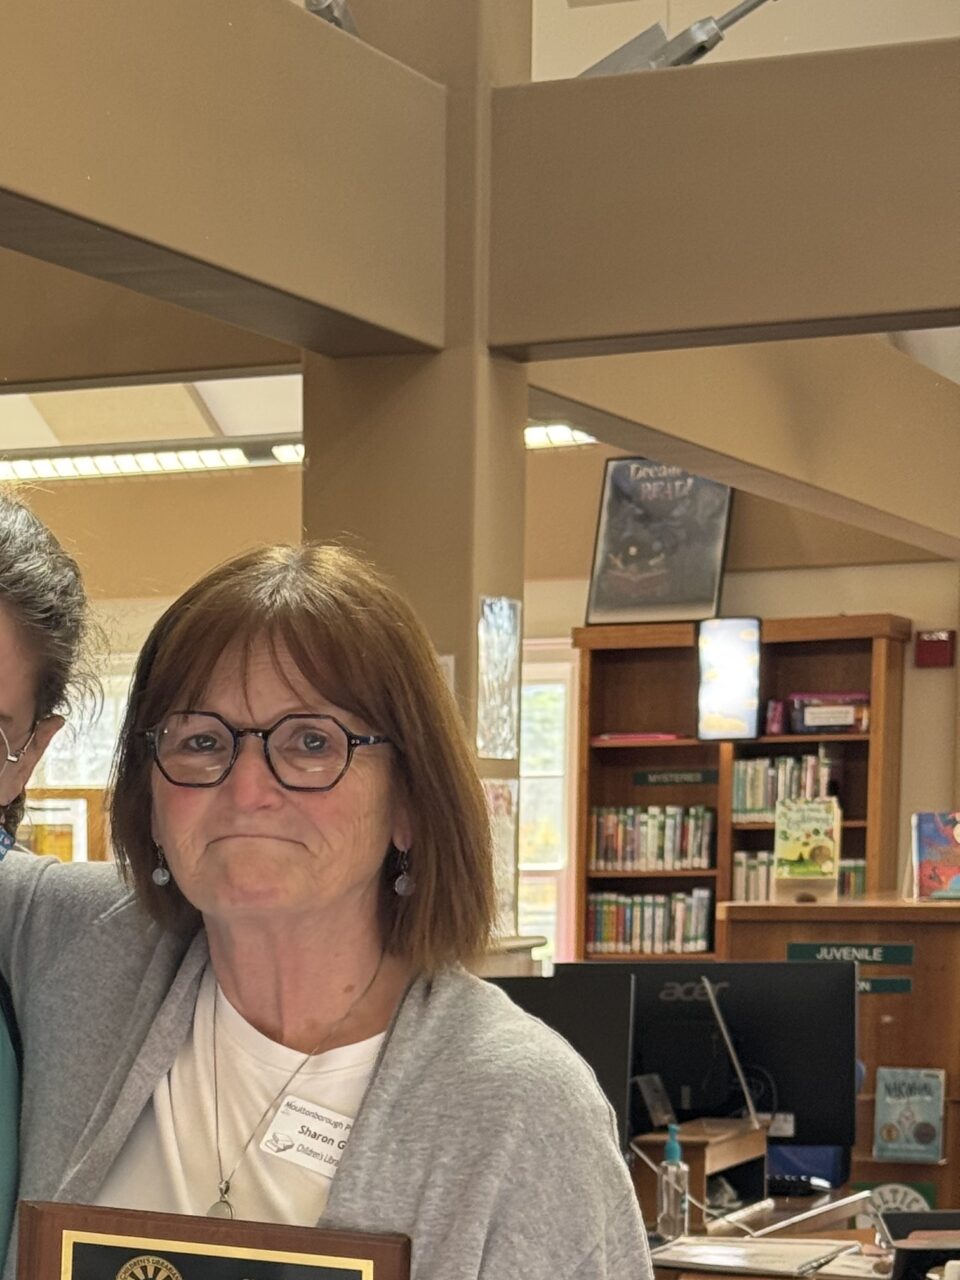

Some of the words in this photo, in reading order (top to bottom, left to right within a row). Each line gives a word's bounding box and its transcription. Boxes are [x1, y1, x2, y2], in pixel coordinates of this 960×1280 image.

[816, 947, 883, 961] JUVENILE
[658, 981, 730, 1001] acer
[286, 1101, 343, 1128] Moultonborough
[298, 1125, 335, 1146] Sharon
